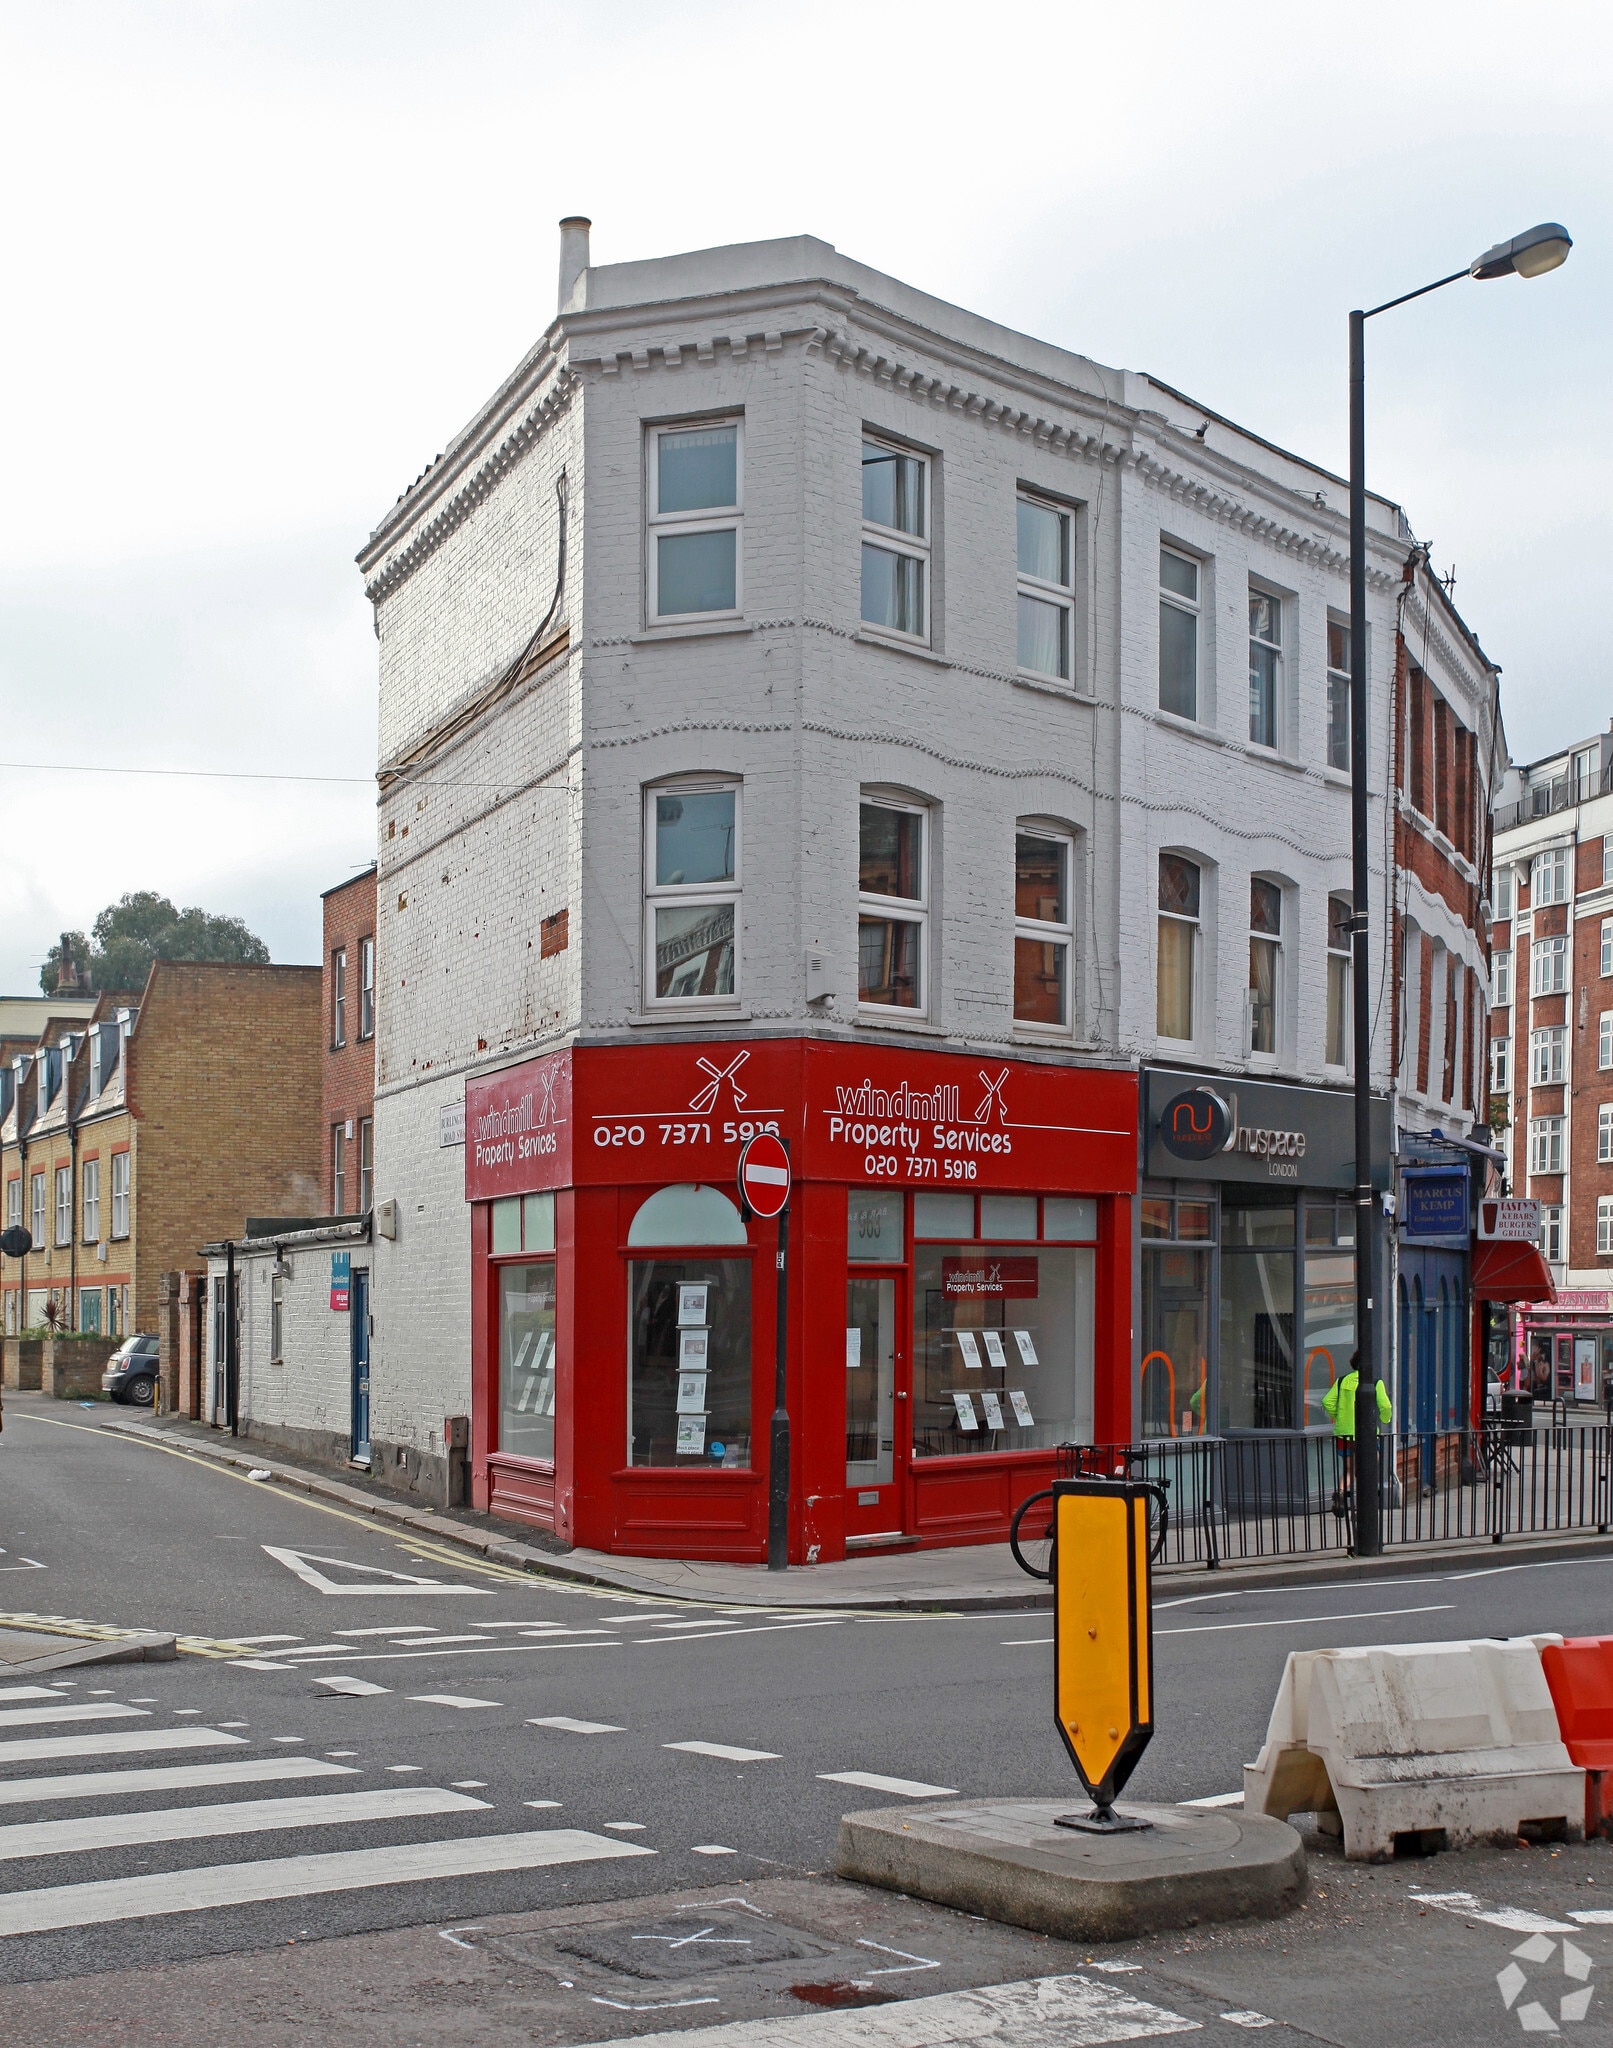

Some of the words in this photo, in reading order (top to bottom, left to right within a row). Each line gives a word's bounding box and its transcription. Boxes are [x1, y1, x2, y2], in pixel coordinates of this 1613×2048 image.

[836, 1078, 959, 1122] windmill
[478, 1093, 533, 1141] windmill
[593, 1125, 645, 1147] 020
[658, 1123, 711, 1144] 7371
[830, 1117, 919, 1154] Property
[933, 1125, 1012, 1153] Services
[1238, 1126, 1306, 1162] nuspace
[476, 1138, 514, 1168] Property
[518, 1131, 557, 1158] Services
[864, 1154, 898, 1176] 020
[905, 1157, 937, 1178] 7371
[944, 1159, 977, 1180] 5916
[1268, 1163, 1298, 1177] LONDON
[1413, 1187, 1462, 1199] MARCUS
[1421, 1200, 1455, 1211] KEMP
[1500, 1201, 1538, 1211] TASTY'S
[1498, 1221, 1537, 1229] BURGERS
[946, 1283, 974, 1293] Property
[976, 1282, 1003, 1291] Services
[1578, 1293, 1607, 1305] NAILS
